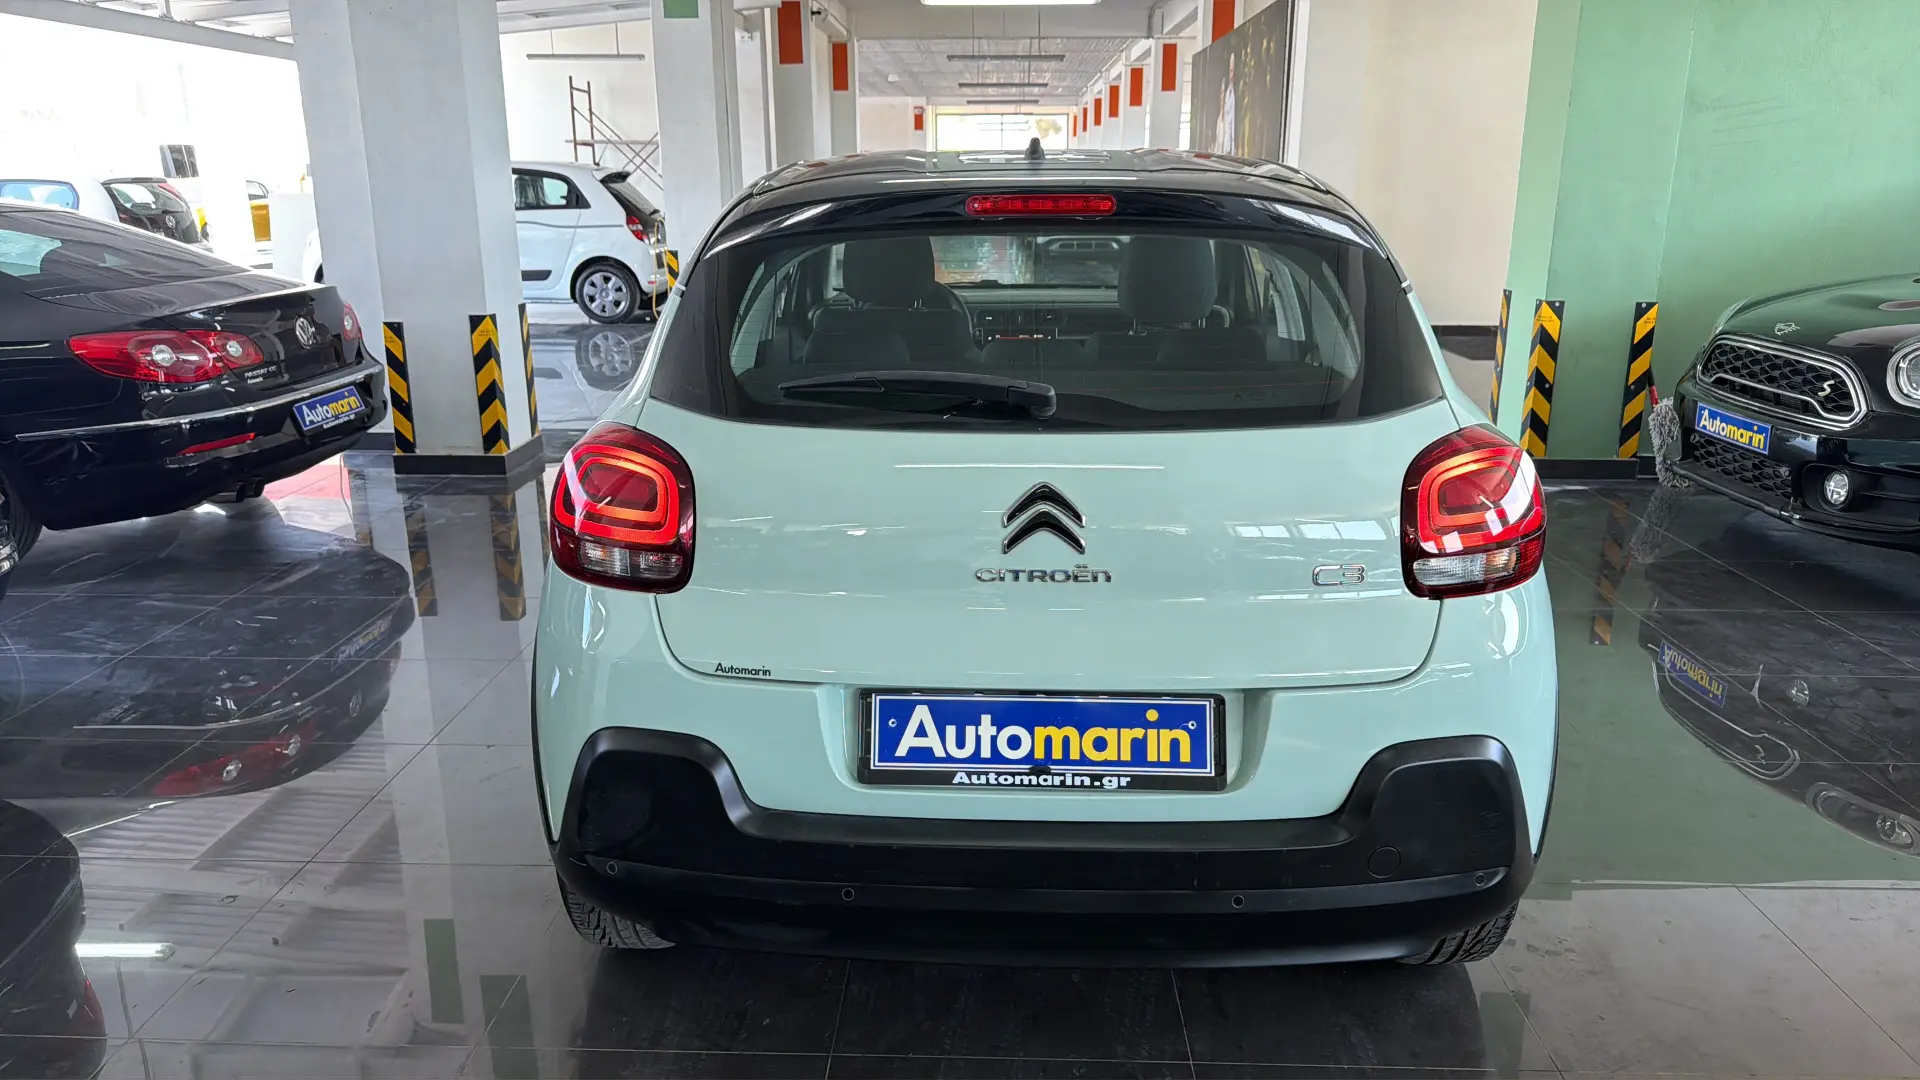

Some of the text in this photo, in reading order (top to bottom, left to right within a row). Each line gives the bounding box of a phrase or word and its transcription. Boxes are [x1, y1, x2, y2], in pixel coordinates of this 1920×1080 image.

[244, 367, 268, 378] PASSAT
[302, 391, 360, 426] Automarin
[1700, 408, 1765, 449] Automarin
[1312, 564, 1366, 587] C3
[715, 662, 771, 677] Automarin
[894, 704, 1191, 763] Automarin
[951, 771, 1131, 790] Automarin.gr
